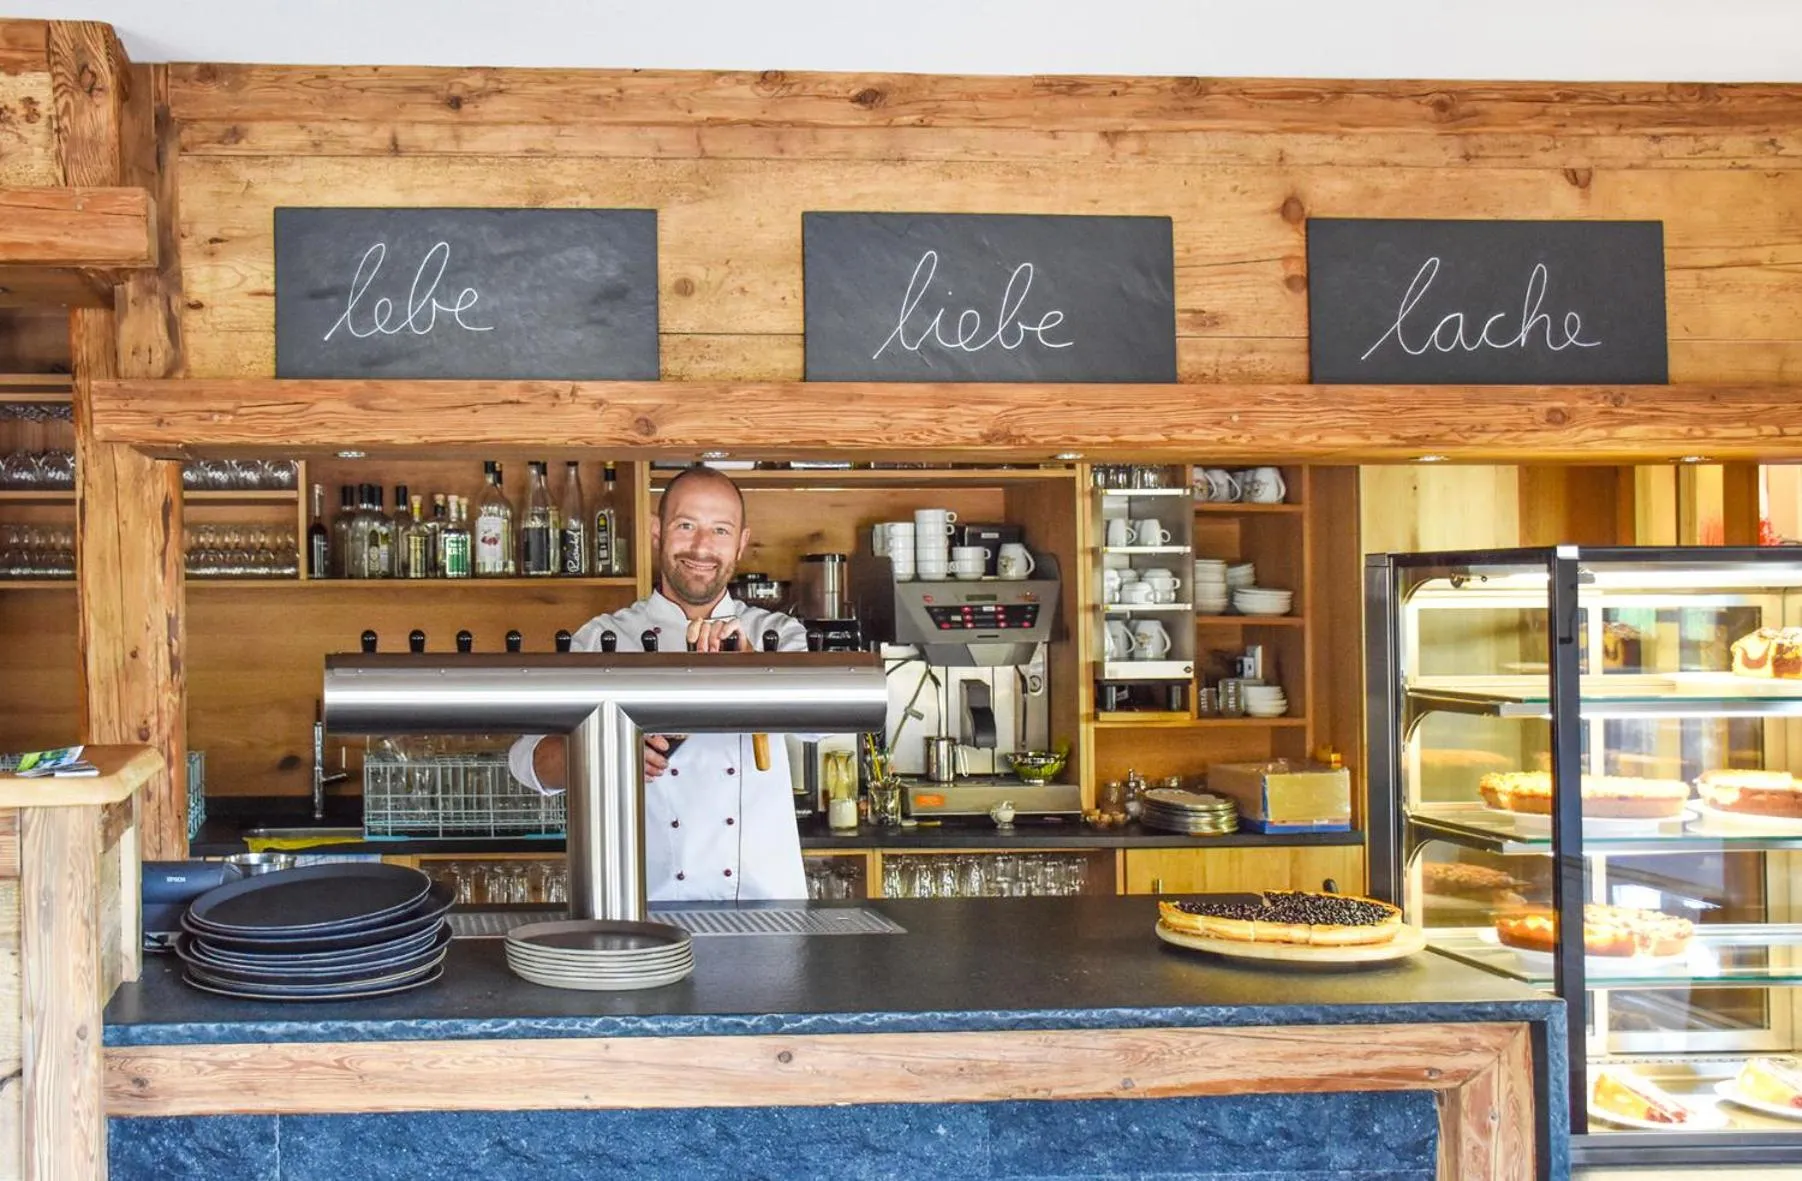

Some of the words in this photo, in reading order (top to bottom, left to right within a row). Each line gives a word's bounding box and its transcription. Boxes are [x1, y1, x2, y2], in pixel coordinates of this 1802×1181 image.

[323, 241, 494, 342] lebe
[872, 250, 1074, 360] liebe
[1360, 256, 1602, 361] lache
